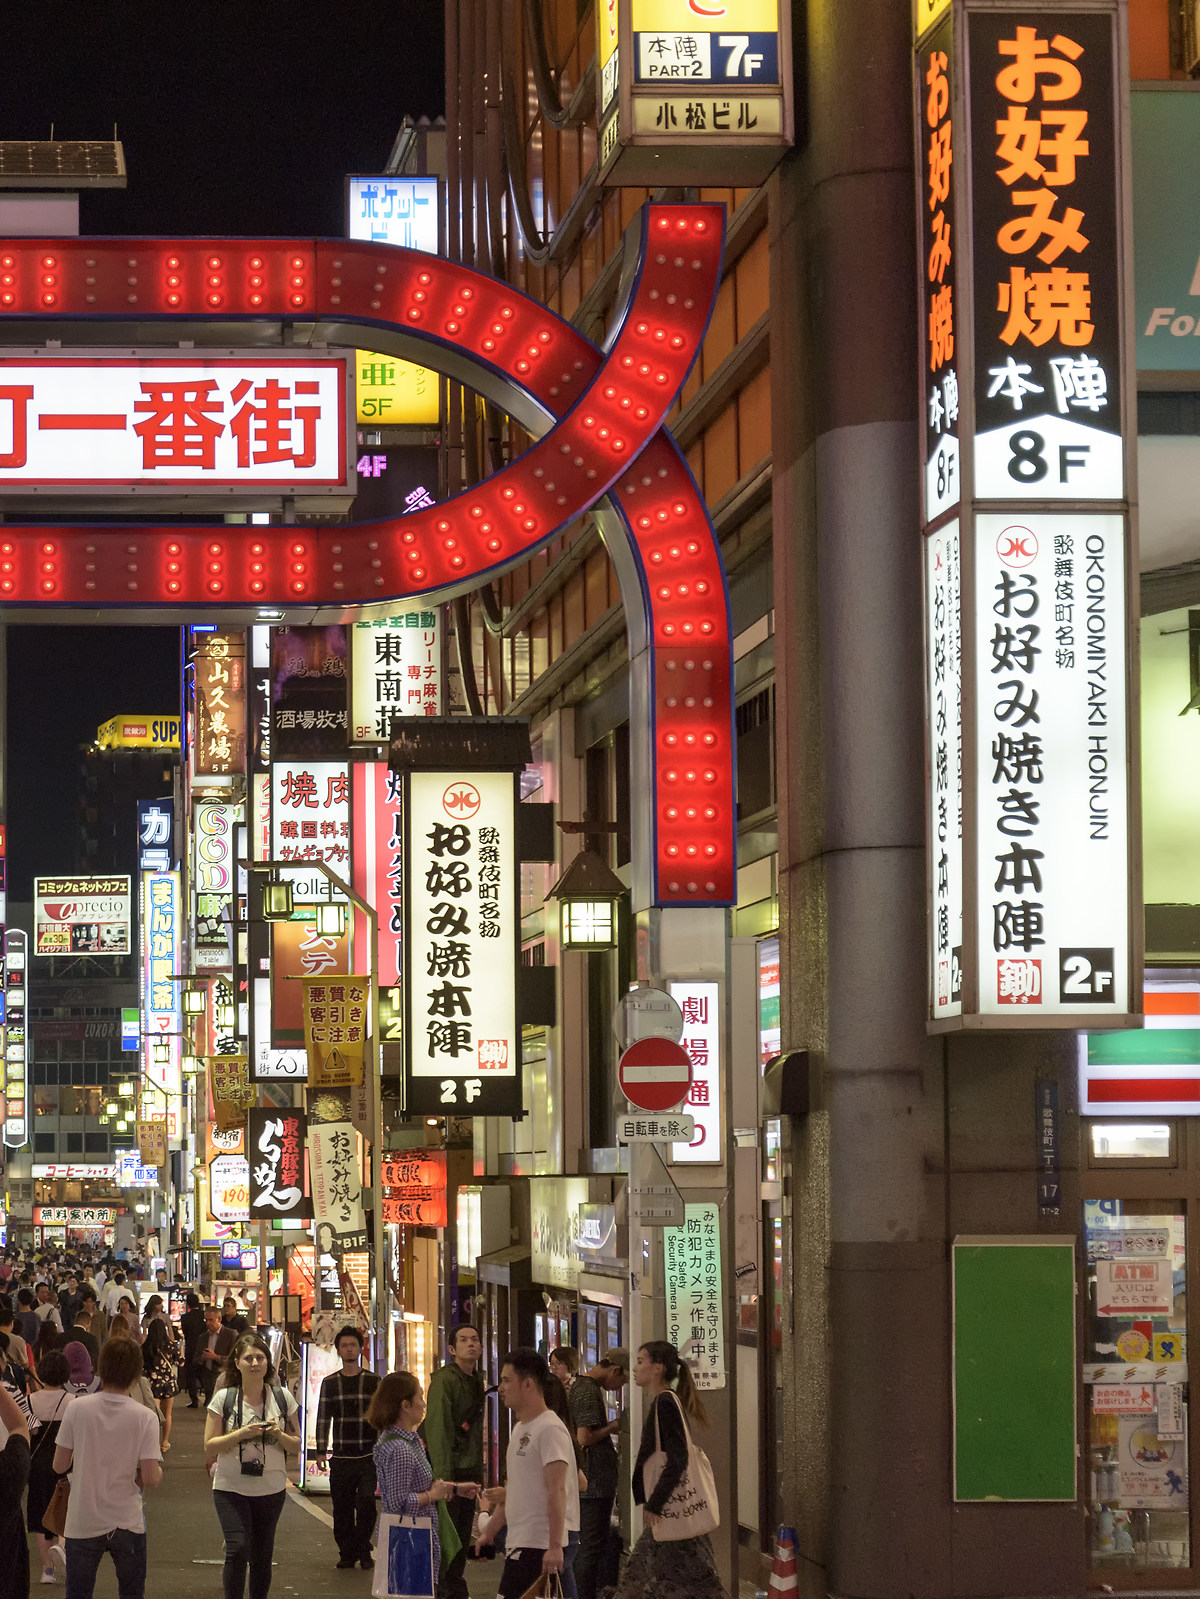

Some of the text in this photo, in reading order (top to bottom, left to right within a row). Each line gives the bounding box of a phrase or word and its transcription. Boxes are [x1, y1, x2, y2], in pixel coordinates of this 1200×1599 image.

[647, 35, 698, 60] 本陣
[718, 35, 764, 78] 7F
[649, 60, 704, 77] PART2
[656, 102, 758, 130] 小松ビル
[360, 183, 430, 219] ポケット
[995, 26, 1096, 349] お好み焼
[926, 50, 955, 374] お好み焼
[929, 368, 960, 435] 本陣
[987, 354, 1109, 414] 本陣
[361, 398, 393, 417] 5F
[356, 455, 387, 478] 4F
[936, 447, 955, 501] 8F
[1007, 429, 1091, 485] 8F
[1053, 533, 1075, 670] 歌舞伎町名物
[278, 626, 290, 635] 2F
[374, 633, 403, 738] 東南荘
[407, 665, 422, 717] 専門
[1085, 534, 1109, 841] OKONOMIYAKI HONJIN
[207, 661, 231, 760] 山久農場
[152, 720, 182, 743] SUP
[355, 726, 372, 739] 3F
[212, 764, 230, 773] 5F
[990, 569, 1046, 954] お好み焼き本陣
[280, 770, 349, 809] 焼肉
[198, 805, 230, 892] GOD
[280, 843, 349, 863] サムギョプサ
[38, 881, 128, 895] コミック&ネットカフェ
[424, 821, 475, 1059] お好み焼本陣
[998, 959, 1041, 997] 鋤
[1063, 952, 1113, 995] 2F
[309, 986, 364, 1004] 悪質な
[310, 1006, 363, 1024] 客引き
[310, 1026, 362, 1044] に注意
[479, 1039, 508, 1064] 鋤
[440, 1078, 483, 1104] 2F
[683, 996, 711, 1148] 劇場通り
[623, 1120, 690, 1138] 自転車を除く
[281, 1116, 300, 1187] 東京豚骨
[45, 1165, 84, 1177] コーヒー
[327, 1131, 361, 1223] お好み焼き
[1041, 1184, 1058, 1199] 17
[41, 1208, 110, 1222] 無料案内所
[343, 1235, 367, 1250] B1F
[667, 1235, 680, 1322] Security Camera in
[677, 1238, 688, 1290] Your Safety
[1114, 1265, 1155, 1280] ATM
[687, 1219, 706, 1359] 防犯カメラ作動中
[703, 1211, 719, 1366] みなさまの安全を守ります
